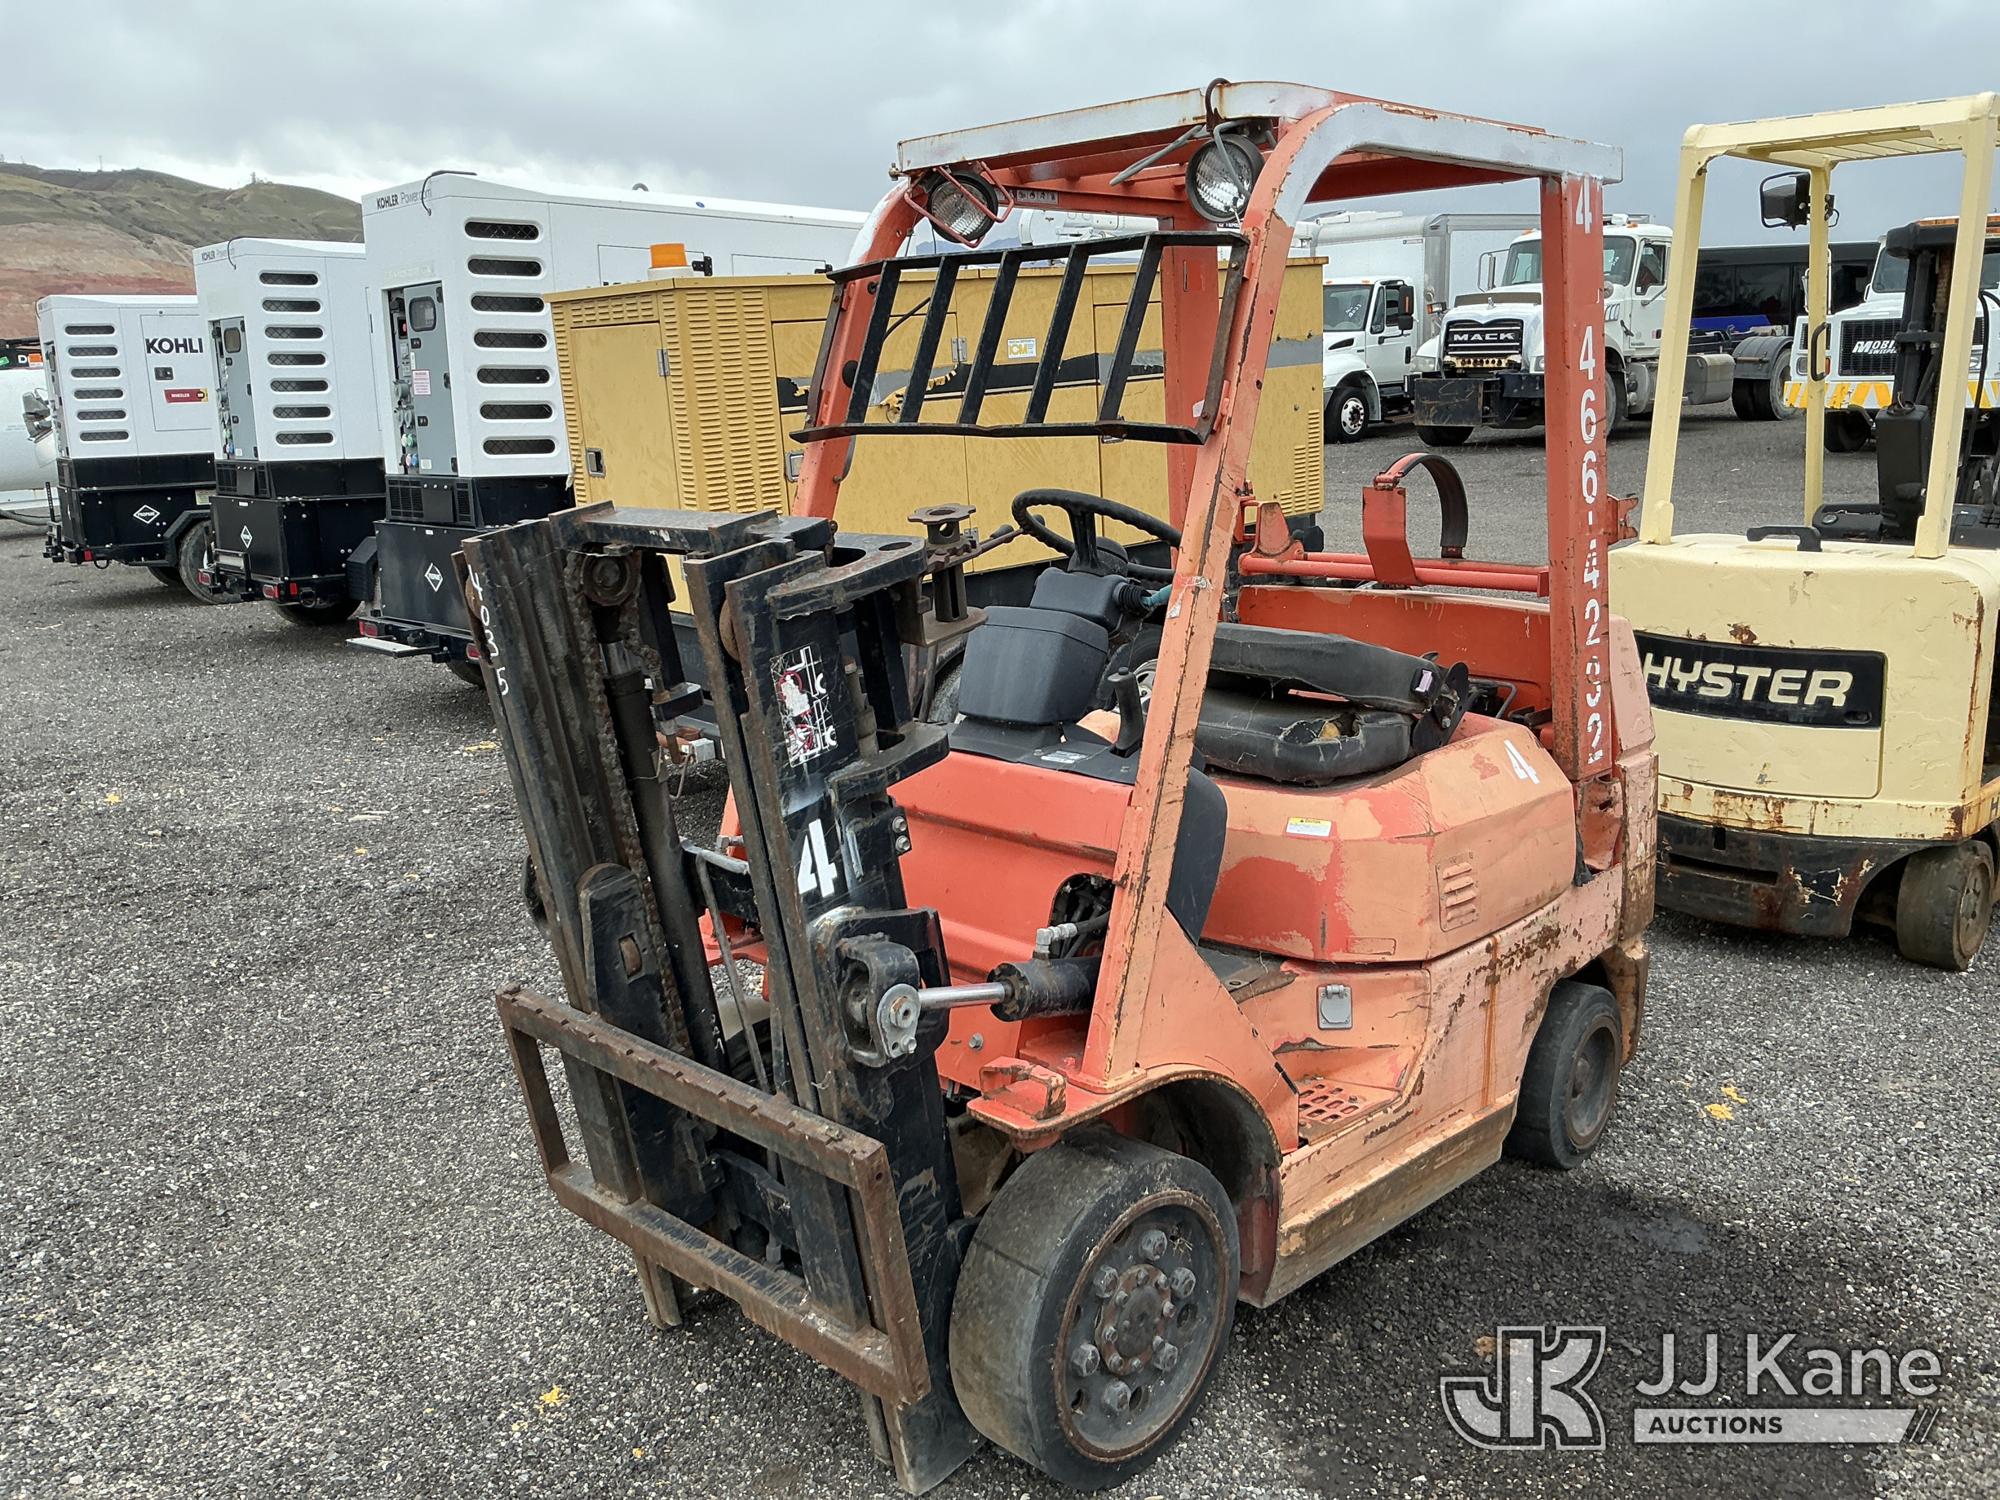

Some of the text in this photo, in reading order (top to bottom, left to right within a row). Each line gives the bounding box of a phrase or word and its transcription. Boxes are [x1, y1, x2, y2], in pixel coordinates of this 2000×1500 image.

[376, 193, 399, 209] KOHLER
[1575, 173, 1593, 234] 4
[1453, 332, 1514, 341] MACK
[1642, 652, 1854, 708] HYSTER
[1503, 739, 1541, 785] 4
[797, 818, 838, 898] 4
